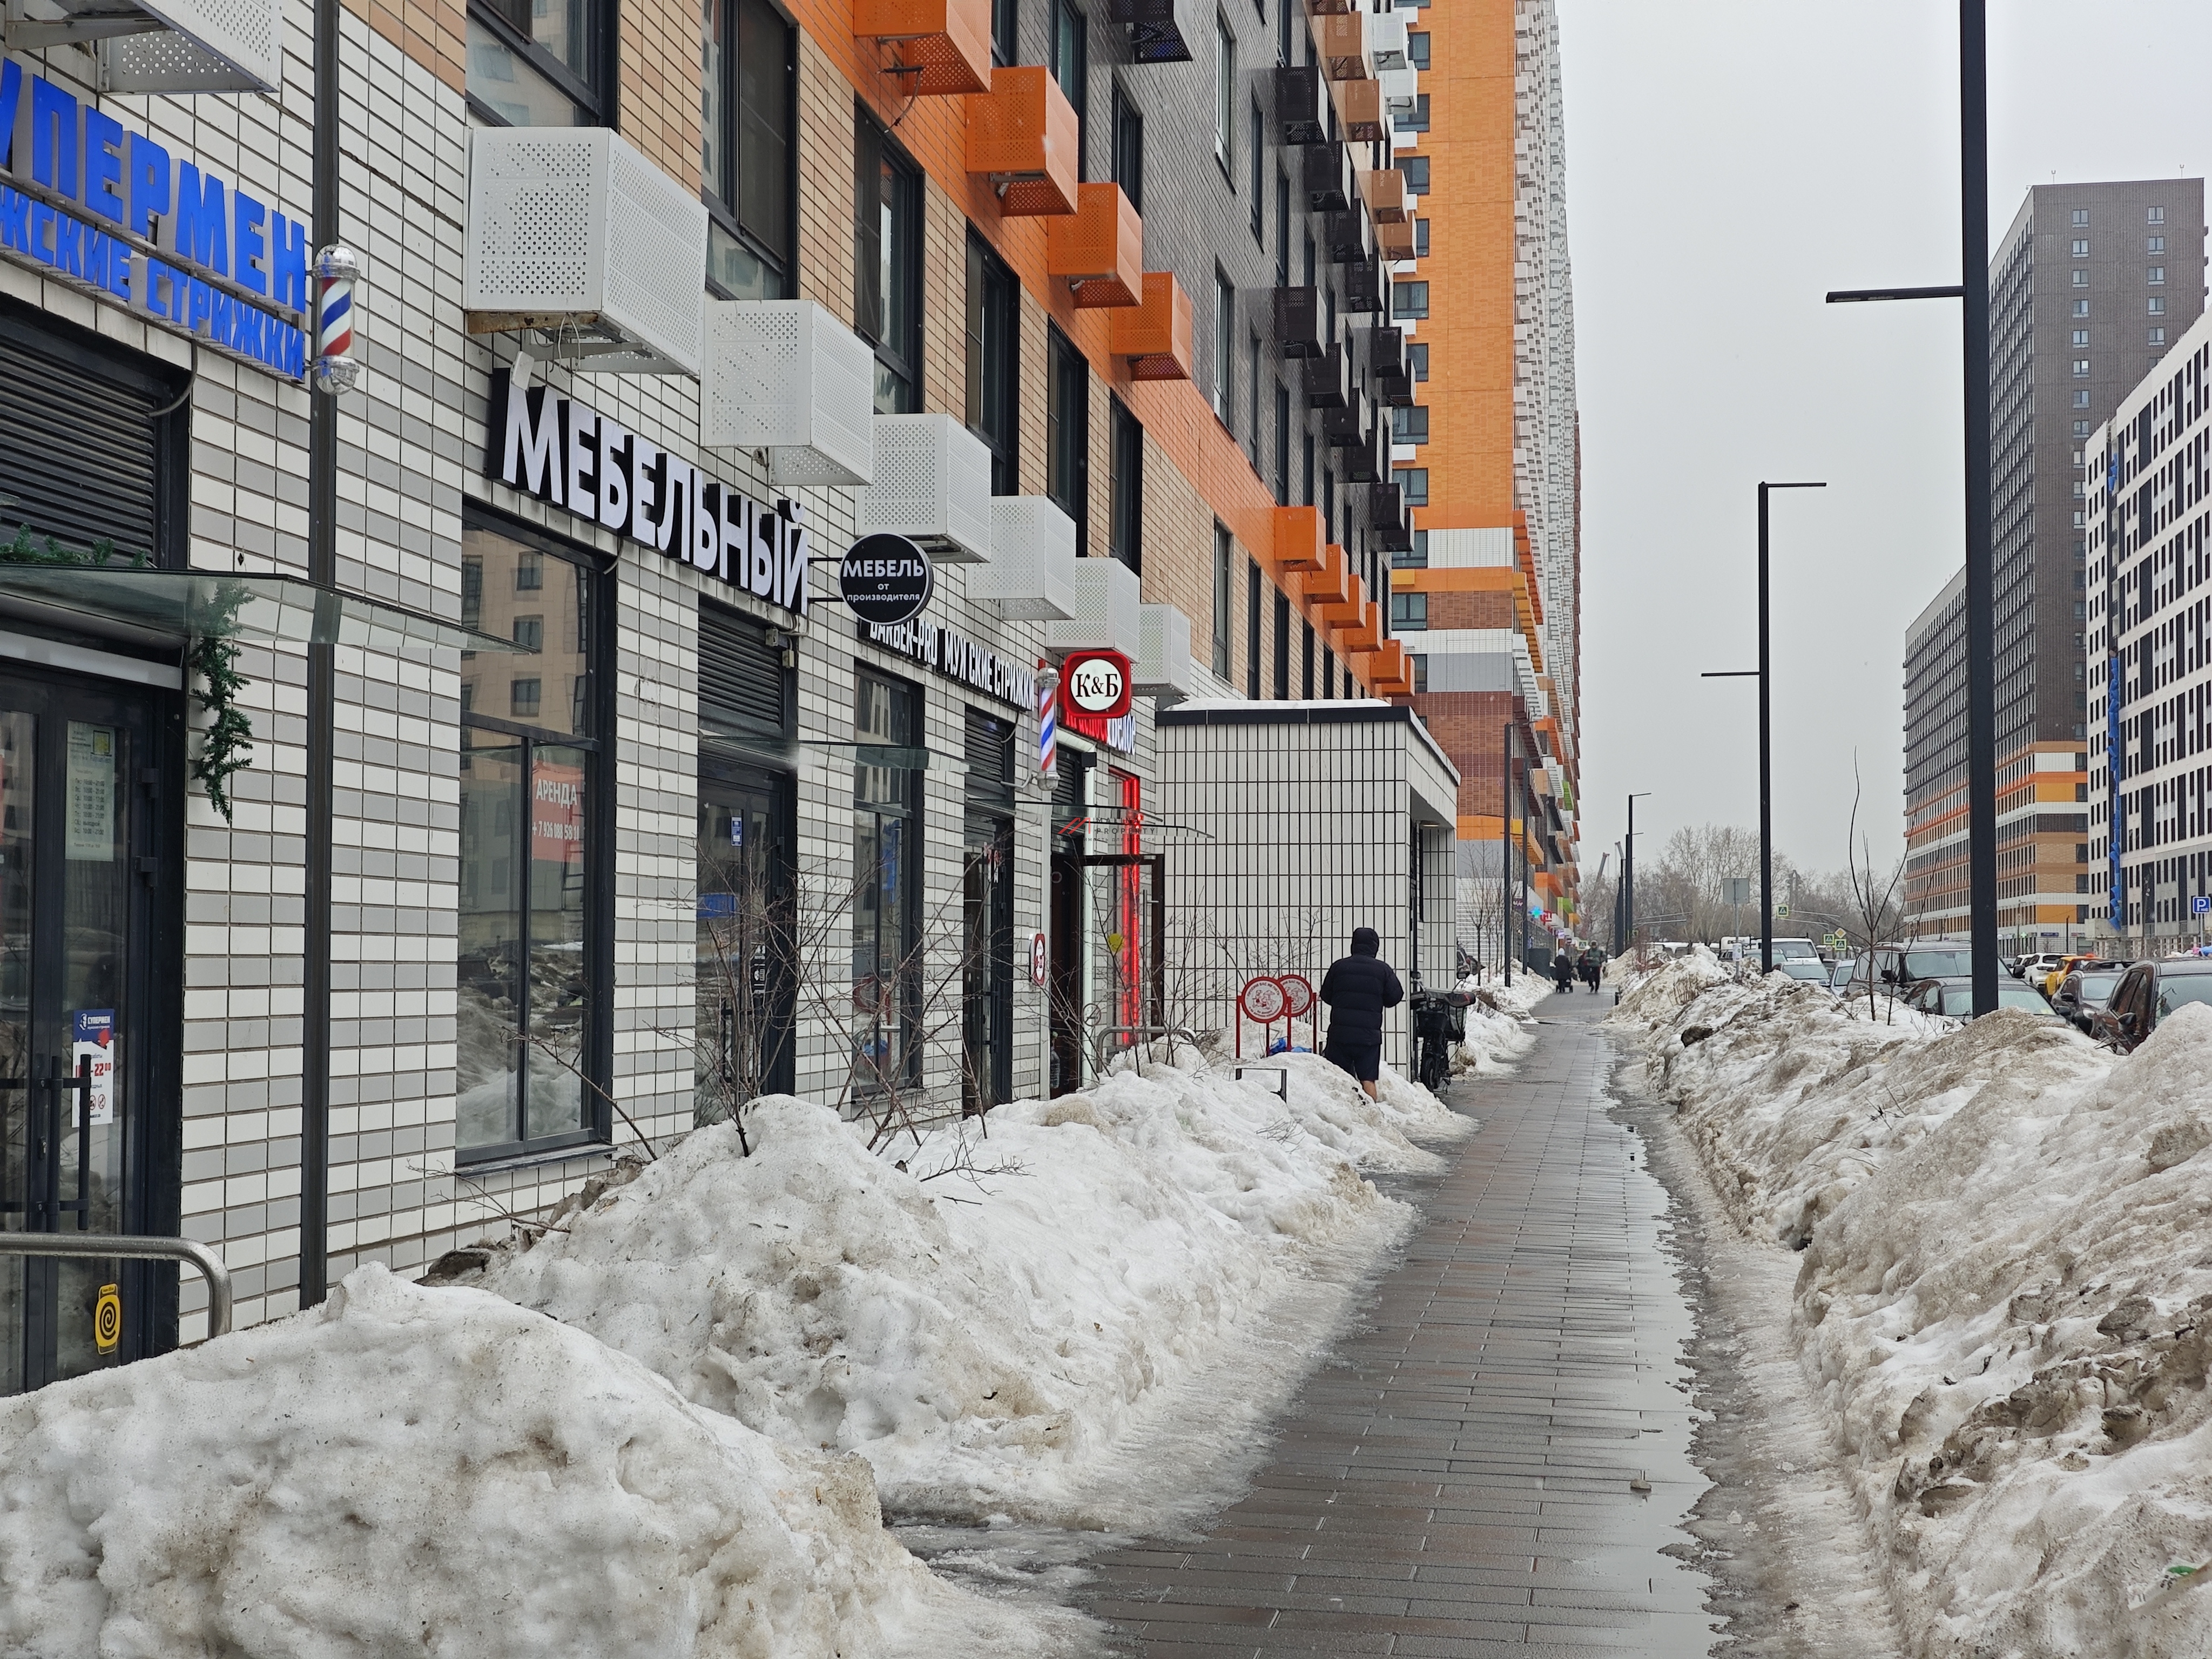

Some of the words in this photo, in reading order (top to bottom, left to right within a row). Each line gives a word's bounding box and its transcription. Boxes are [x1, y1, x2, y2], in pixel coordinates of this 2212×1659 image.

[147, 257, 304, 380] СТРИЖКИ
[500, 373, 808, 616] МЕБЕЛЬНЫЙ
[842, 559, 925, 577] МЕБЕЛЬ
[847, 594, 920, 603] производителя
[995, 656, 1035, 711] СТРИЖКИ
[1076, 673, 1118, 697] К&Б
[536, 778, 577, 810] АРЕНДА
